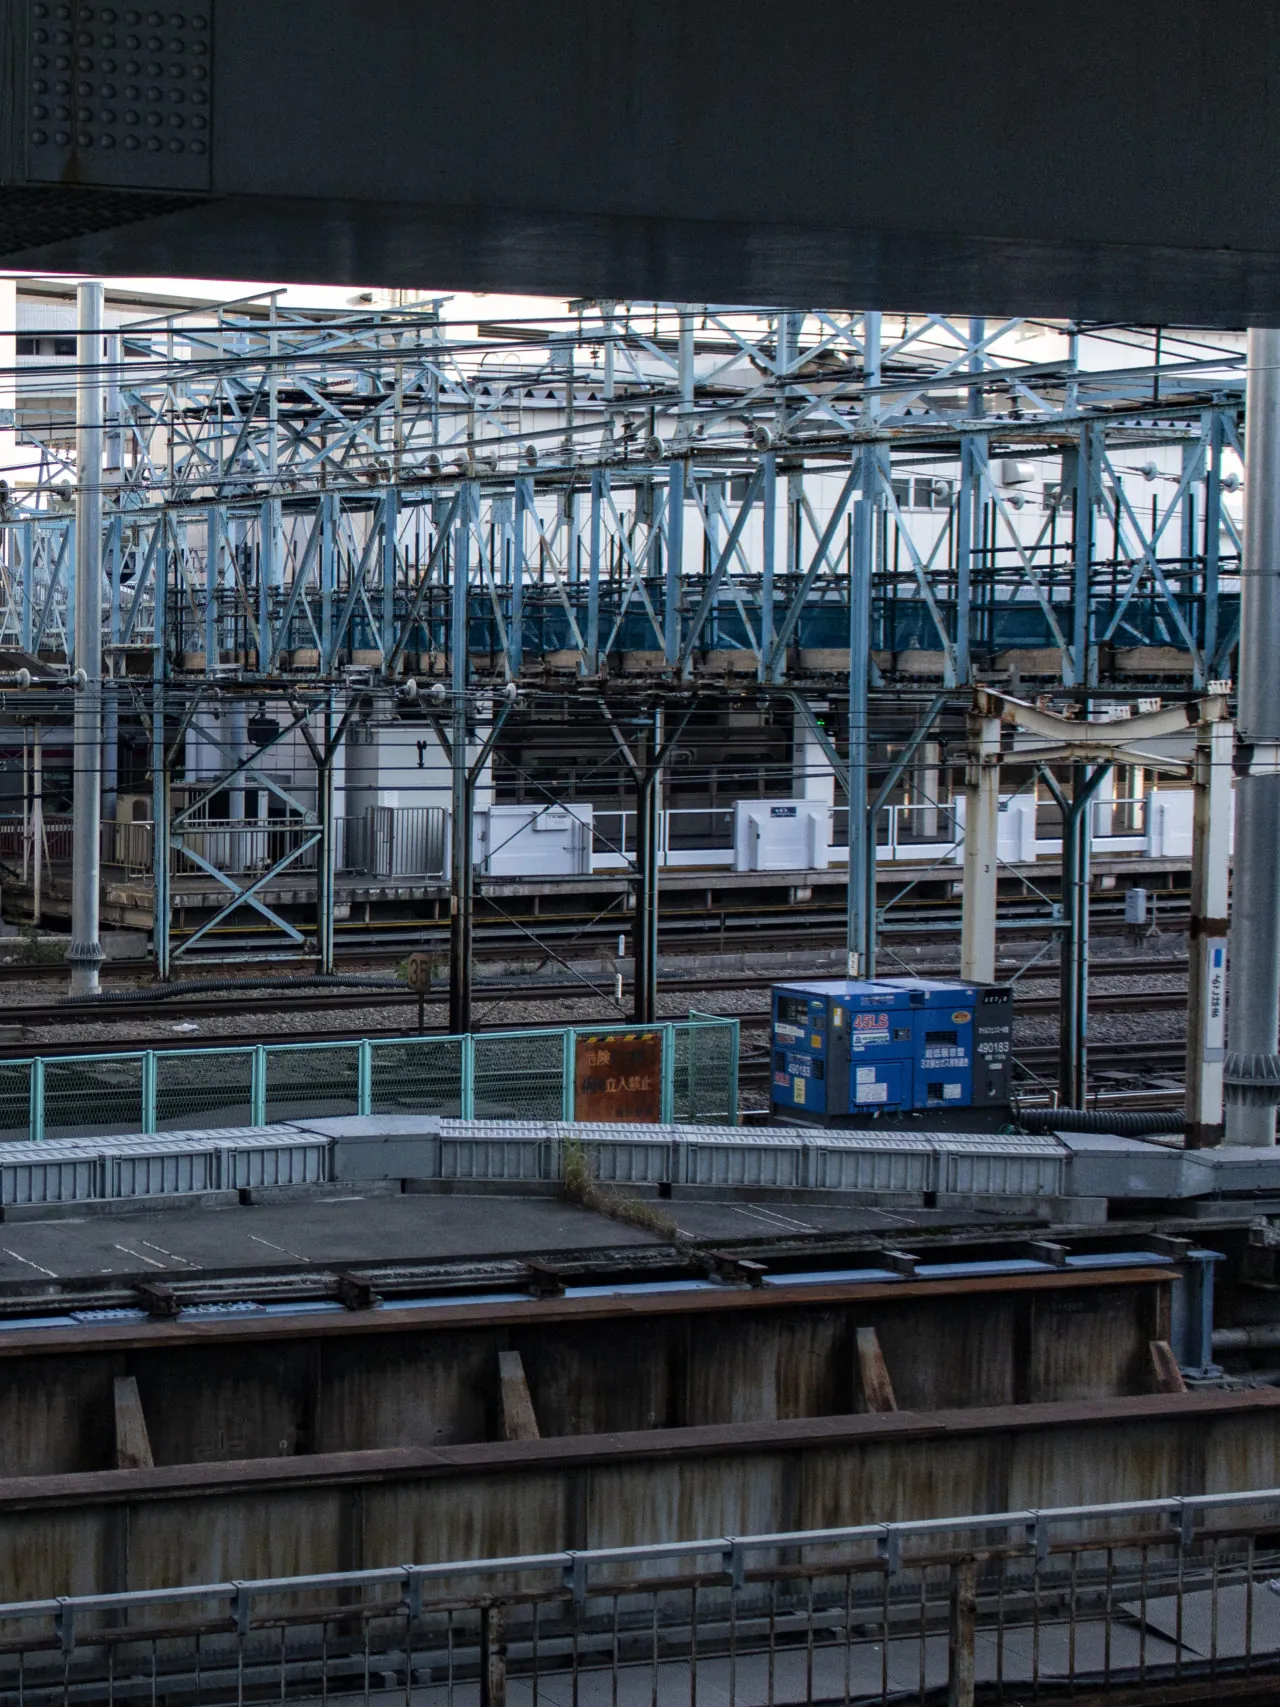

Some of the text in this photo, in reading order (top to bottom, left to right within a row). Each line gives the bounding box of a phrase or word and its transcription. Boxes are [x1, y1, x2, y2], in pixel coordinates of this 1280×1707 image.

[410, 958, 428, 986] 35
[853, 1013, 889, 1029] 45LS
[605, 1076, 653, 1093] 立入禁止
